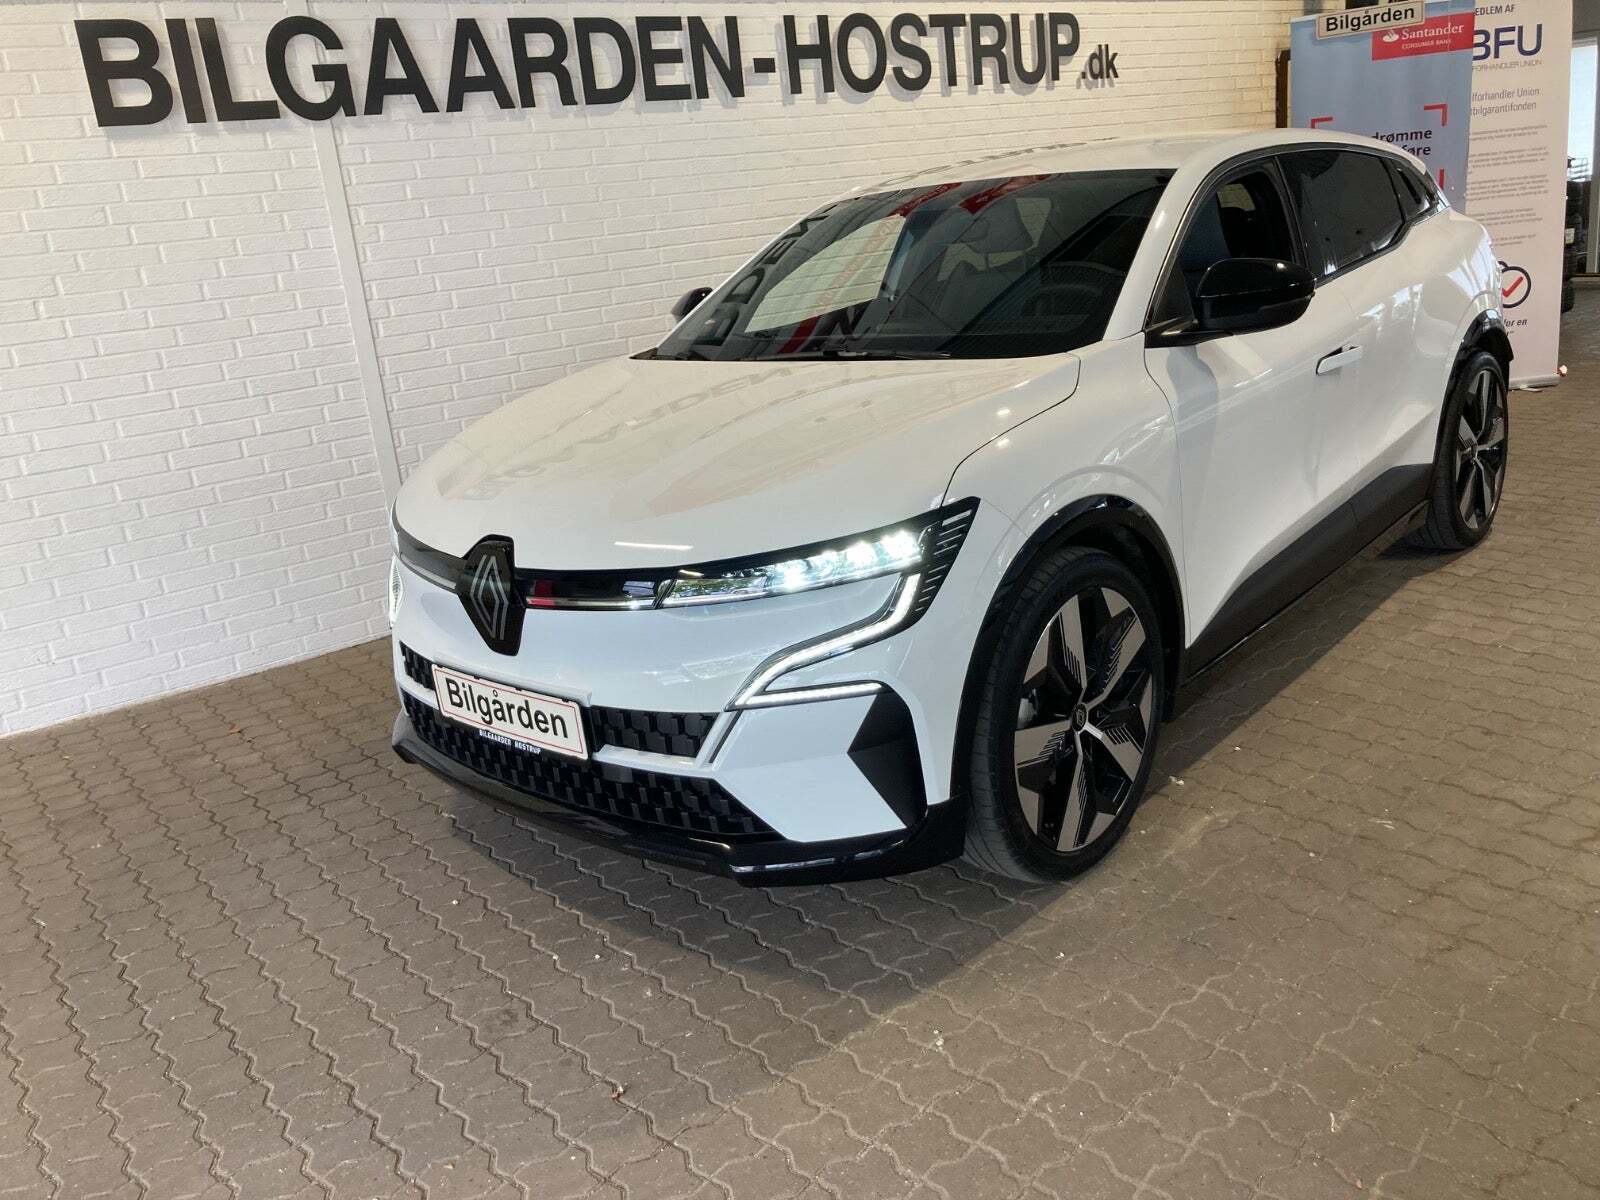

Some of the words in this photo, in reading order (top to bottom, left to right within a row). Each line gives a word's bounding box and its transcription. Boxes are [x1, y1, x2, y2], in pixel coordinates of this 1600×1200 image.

[1474, 6, 1503, 16] EDLEM
[1326, 7, 1415, 32] Bilgården
[1401, 22, 1465, 40] Santander
[1472, 61, 1519, 72] FORHANDLER
[1472, 89, 1516, 102] lforhandler
[1516, 86, 1541, 98] Union
[1471, 101, 1537, 117] bilgarantifonden
[445, 677, 569, 739] Bilgården
